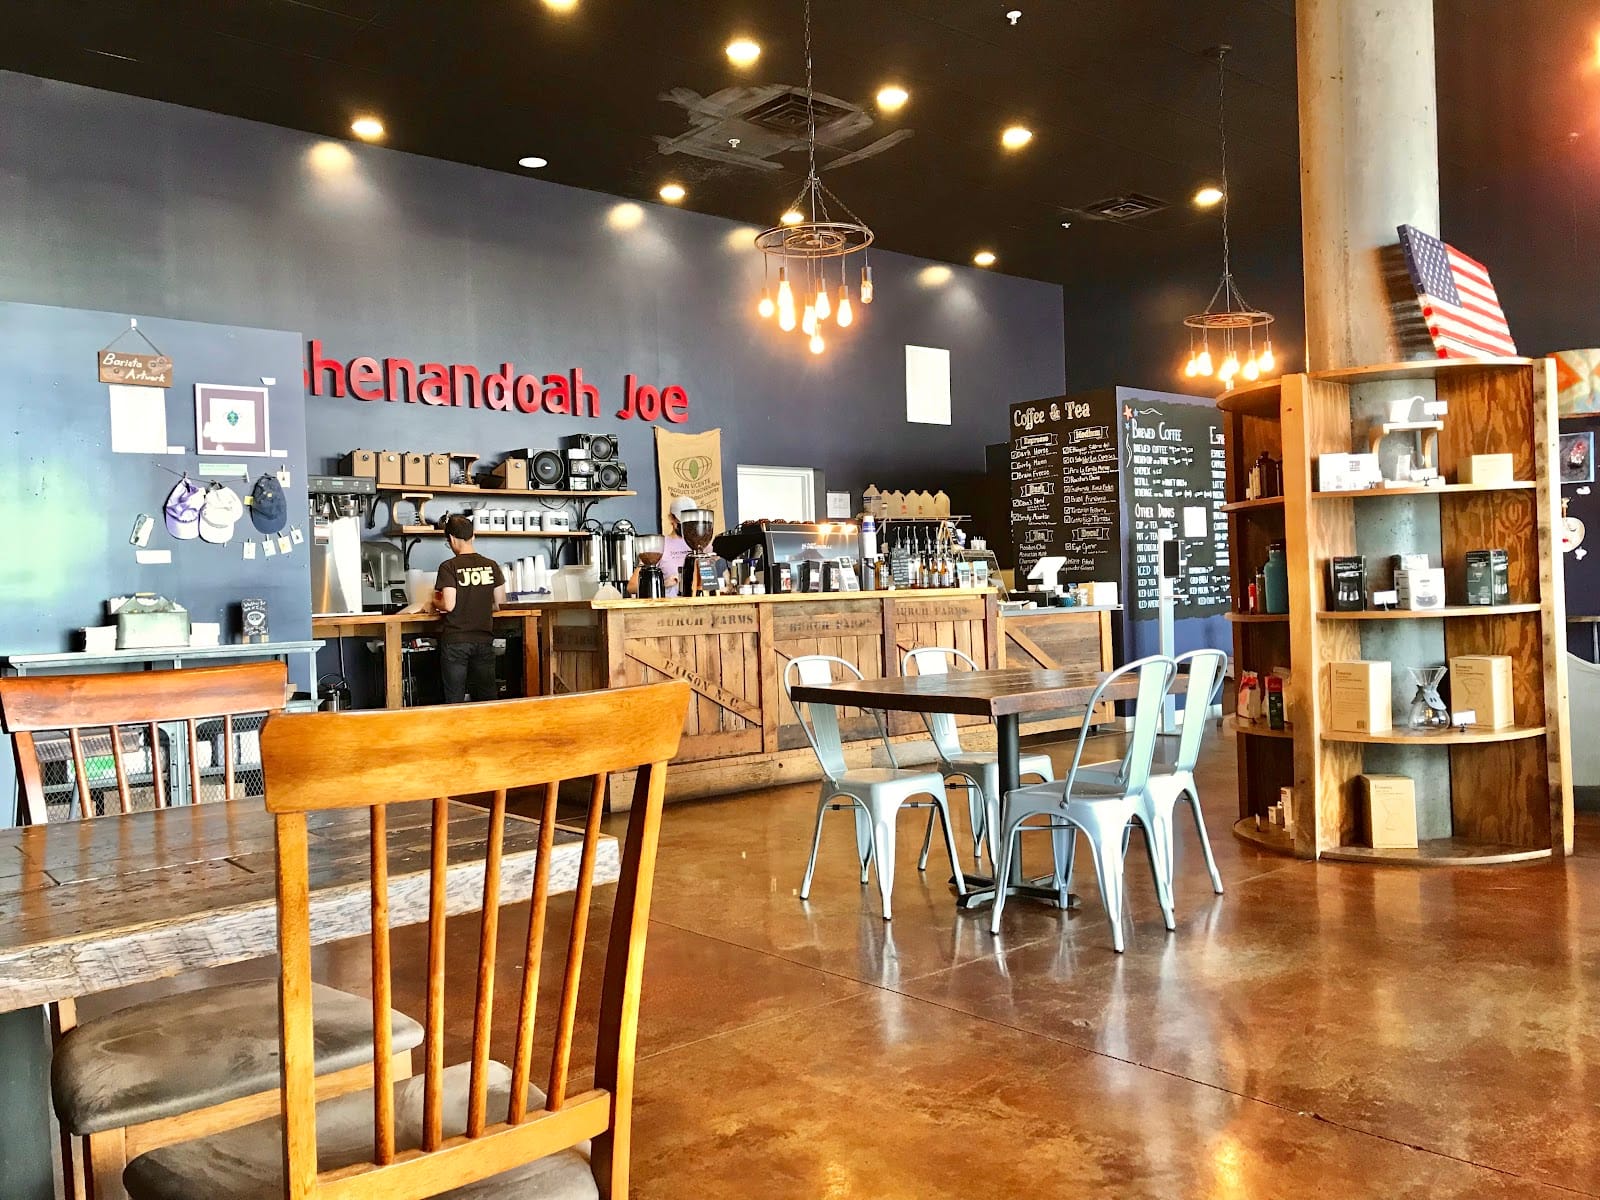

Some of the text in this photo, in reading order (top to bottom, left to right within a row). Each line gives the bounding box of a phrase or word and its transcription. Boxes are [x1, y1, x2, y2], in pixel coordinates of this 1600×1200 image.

[102, 352, 143, 368] Barista
[124, 368, 166, 383] Artwork
[304, 339, 689, 423] henandoah Joe
[1013, 401, 1091, 431] Coffee & Tea
[458, 570, 495, 587] JOE
[711, 614, 754, 625] FARMS
[664, 660, 710, 691] FAISON
